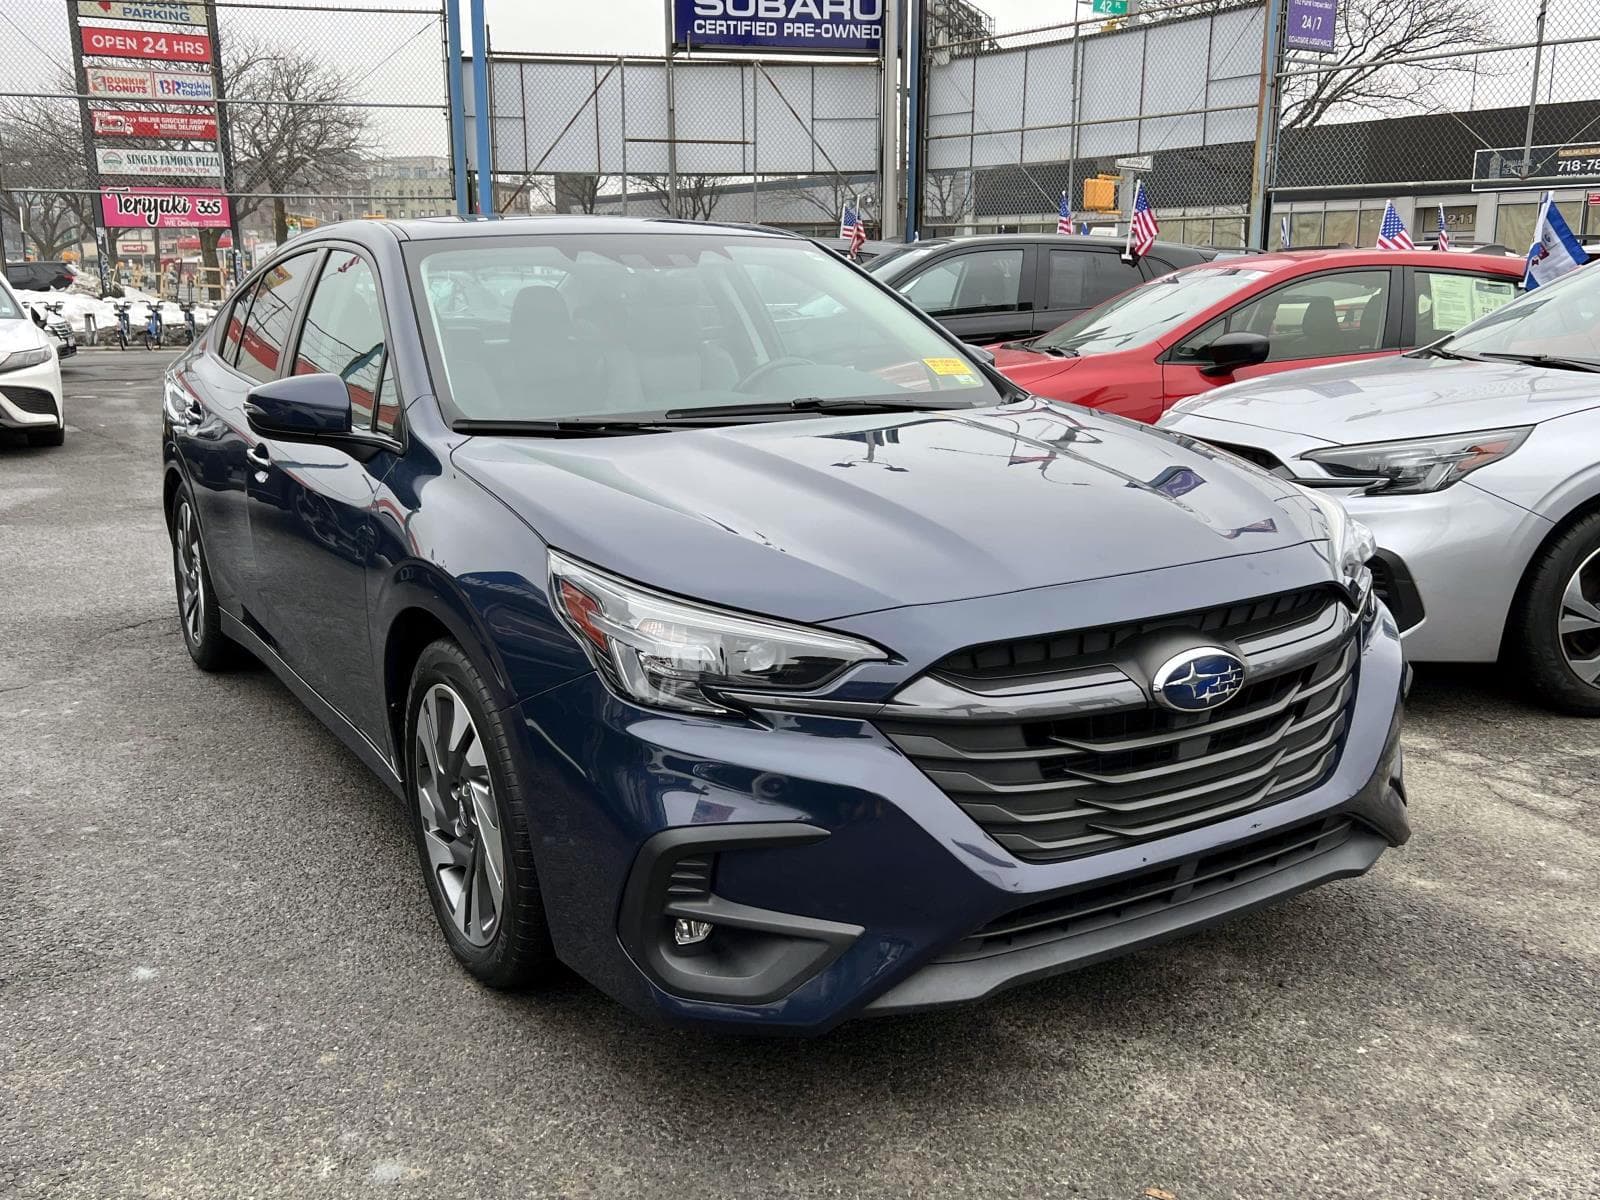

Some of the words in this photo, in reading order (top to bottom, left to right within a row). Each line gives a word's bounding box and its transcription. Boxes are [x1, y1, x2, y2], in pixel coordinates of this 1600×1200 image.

[122, 7, 190, 21] PARKING
[694, 0, 882, 21] SUBARU
[1099, 0, 1112, 13] 42
[693, 19, 777, 37] CERTIFIED
[783, 22, 882, 39] PRE-OWNED
[1301, 14, 1322, 32] 24/7
[91, 34, 138, 50] OPEN
[142, 36, 169, 54] 24
[173, 40, 205, 55] HRS
[107, 84, 148, 94] DONUTS
[160, 79, 181, 95] BR
[161, 117, 188, 125] GROCERY
[189, 118, 217, 126] SHOPPIN
[127, 153, 158, 165] SINGAS
[160, 155, 194, 166] FAMOUS
[195, 156, 220, 167] PIZZA
[106, 187, 192, 227] Teriyaki
[196, 199, 222, 216] 365
